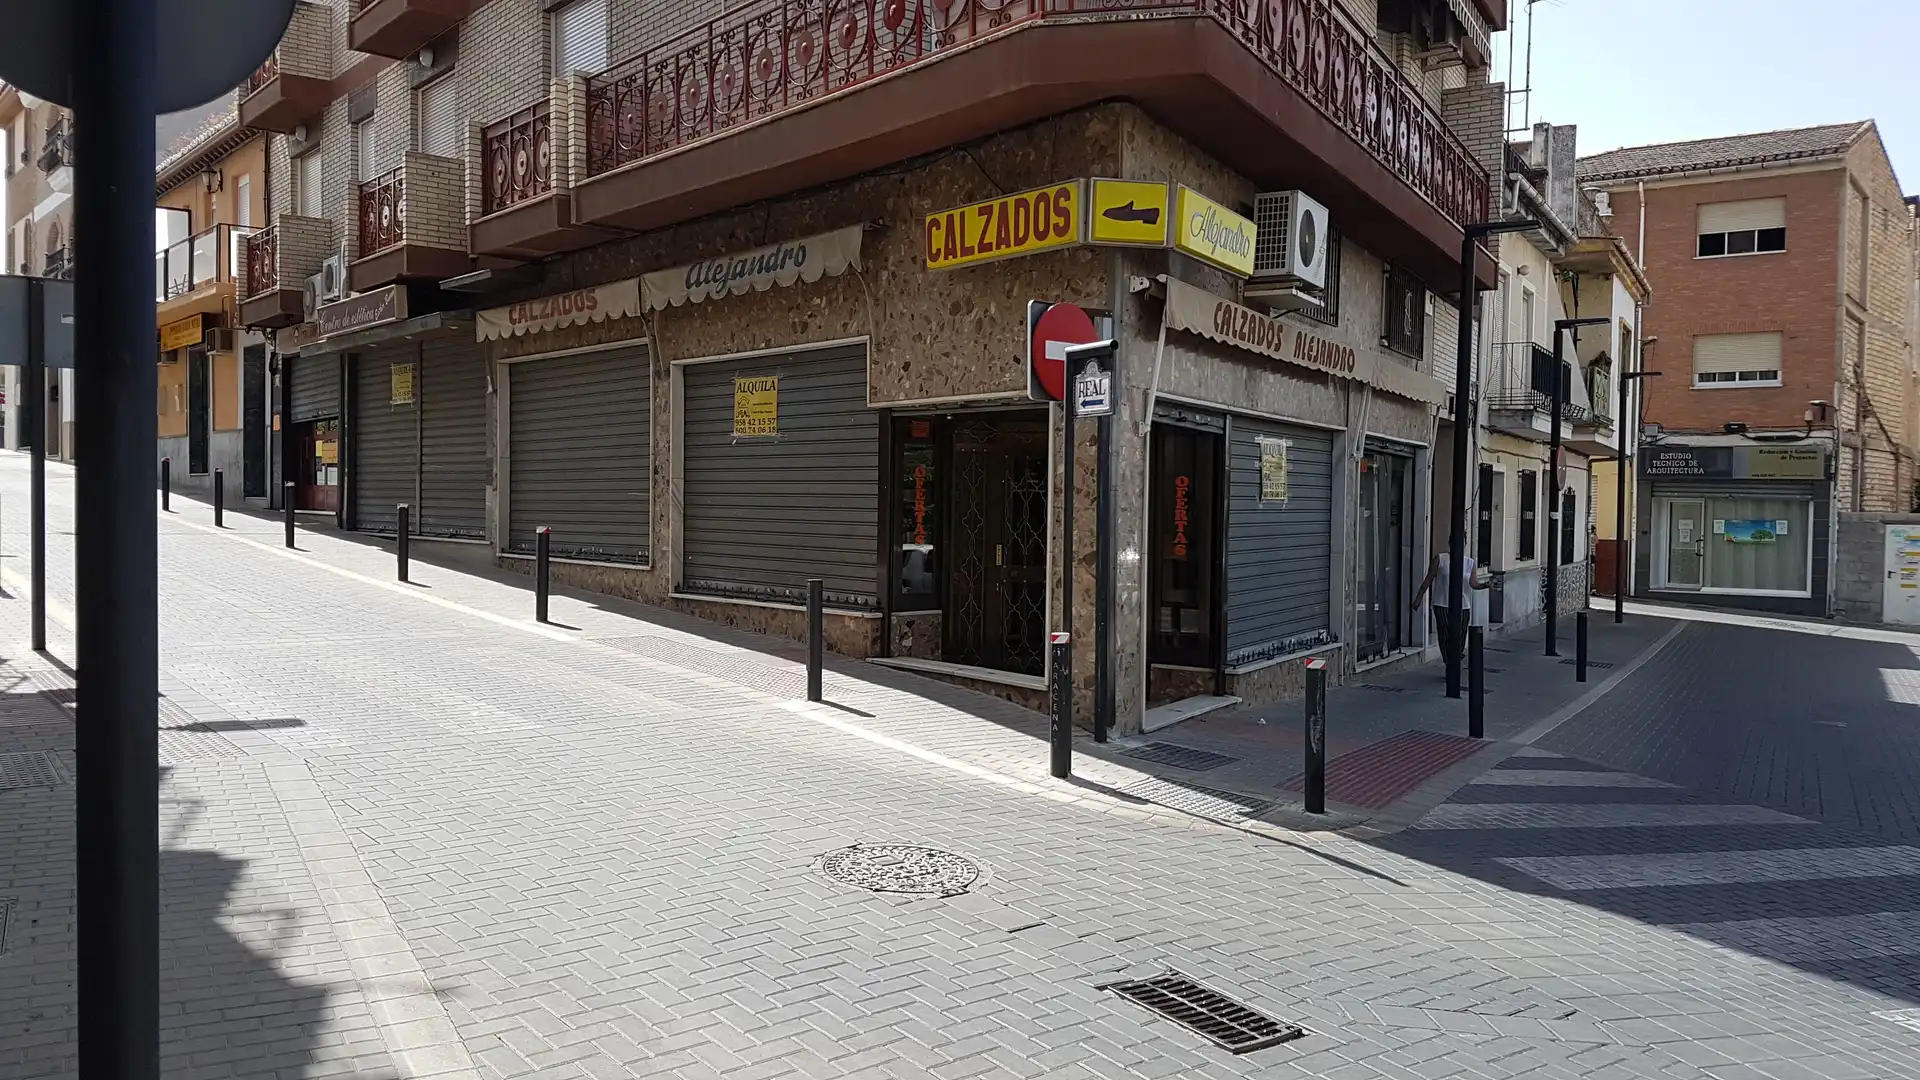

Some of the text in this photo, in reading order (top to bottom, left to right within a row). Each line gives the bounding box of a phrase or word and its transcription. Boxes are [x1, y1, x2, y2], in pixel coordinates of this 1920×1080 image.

[927, 187, 1071, 263] CALZADOS
[1190, 204, 1250, 259] Alejandro
[684, 241, 807, 294] Alejandro
[342, 307, 350, 327] de
[508, 288, 598, 325] CALZADOS
[1213, 301, 1356, 374] CALZADOS ALEJANDRO
[736, 380, 776, 395] ALQUILA
[1078, 378, 1106, 398] REAL
[747, 418, 756, 426] 42
[758, 417, 766, 426] 15
[767, 417, 776, 425] 57
[1660, 452, 1692, 460] ESTUDIO
[914, 464, 926, 545] OFERTAS
[1173, 475, 1189, 556] OFERTAS
